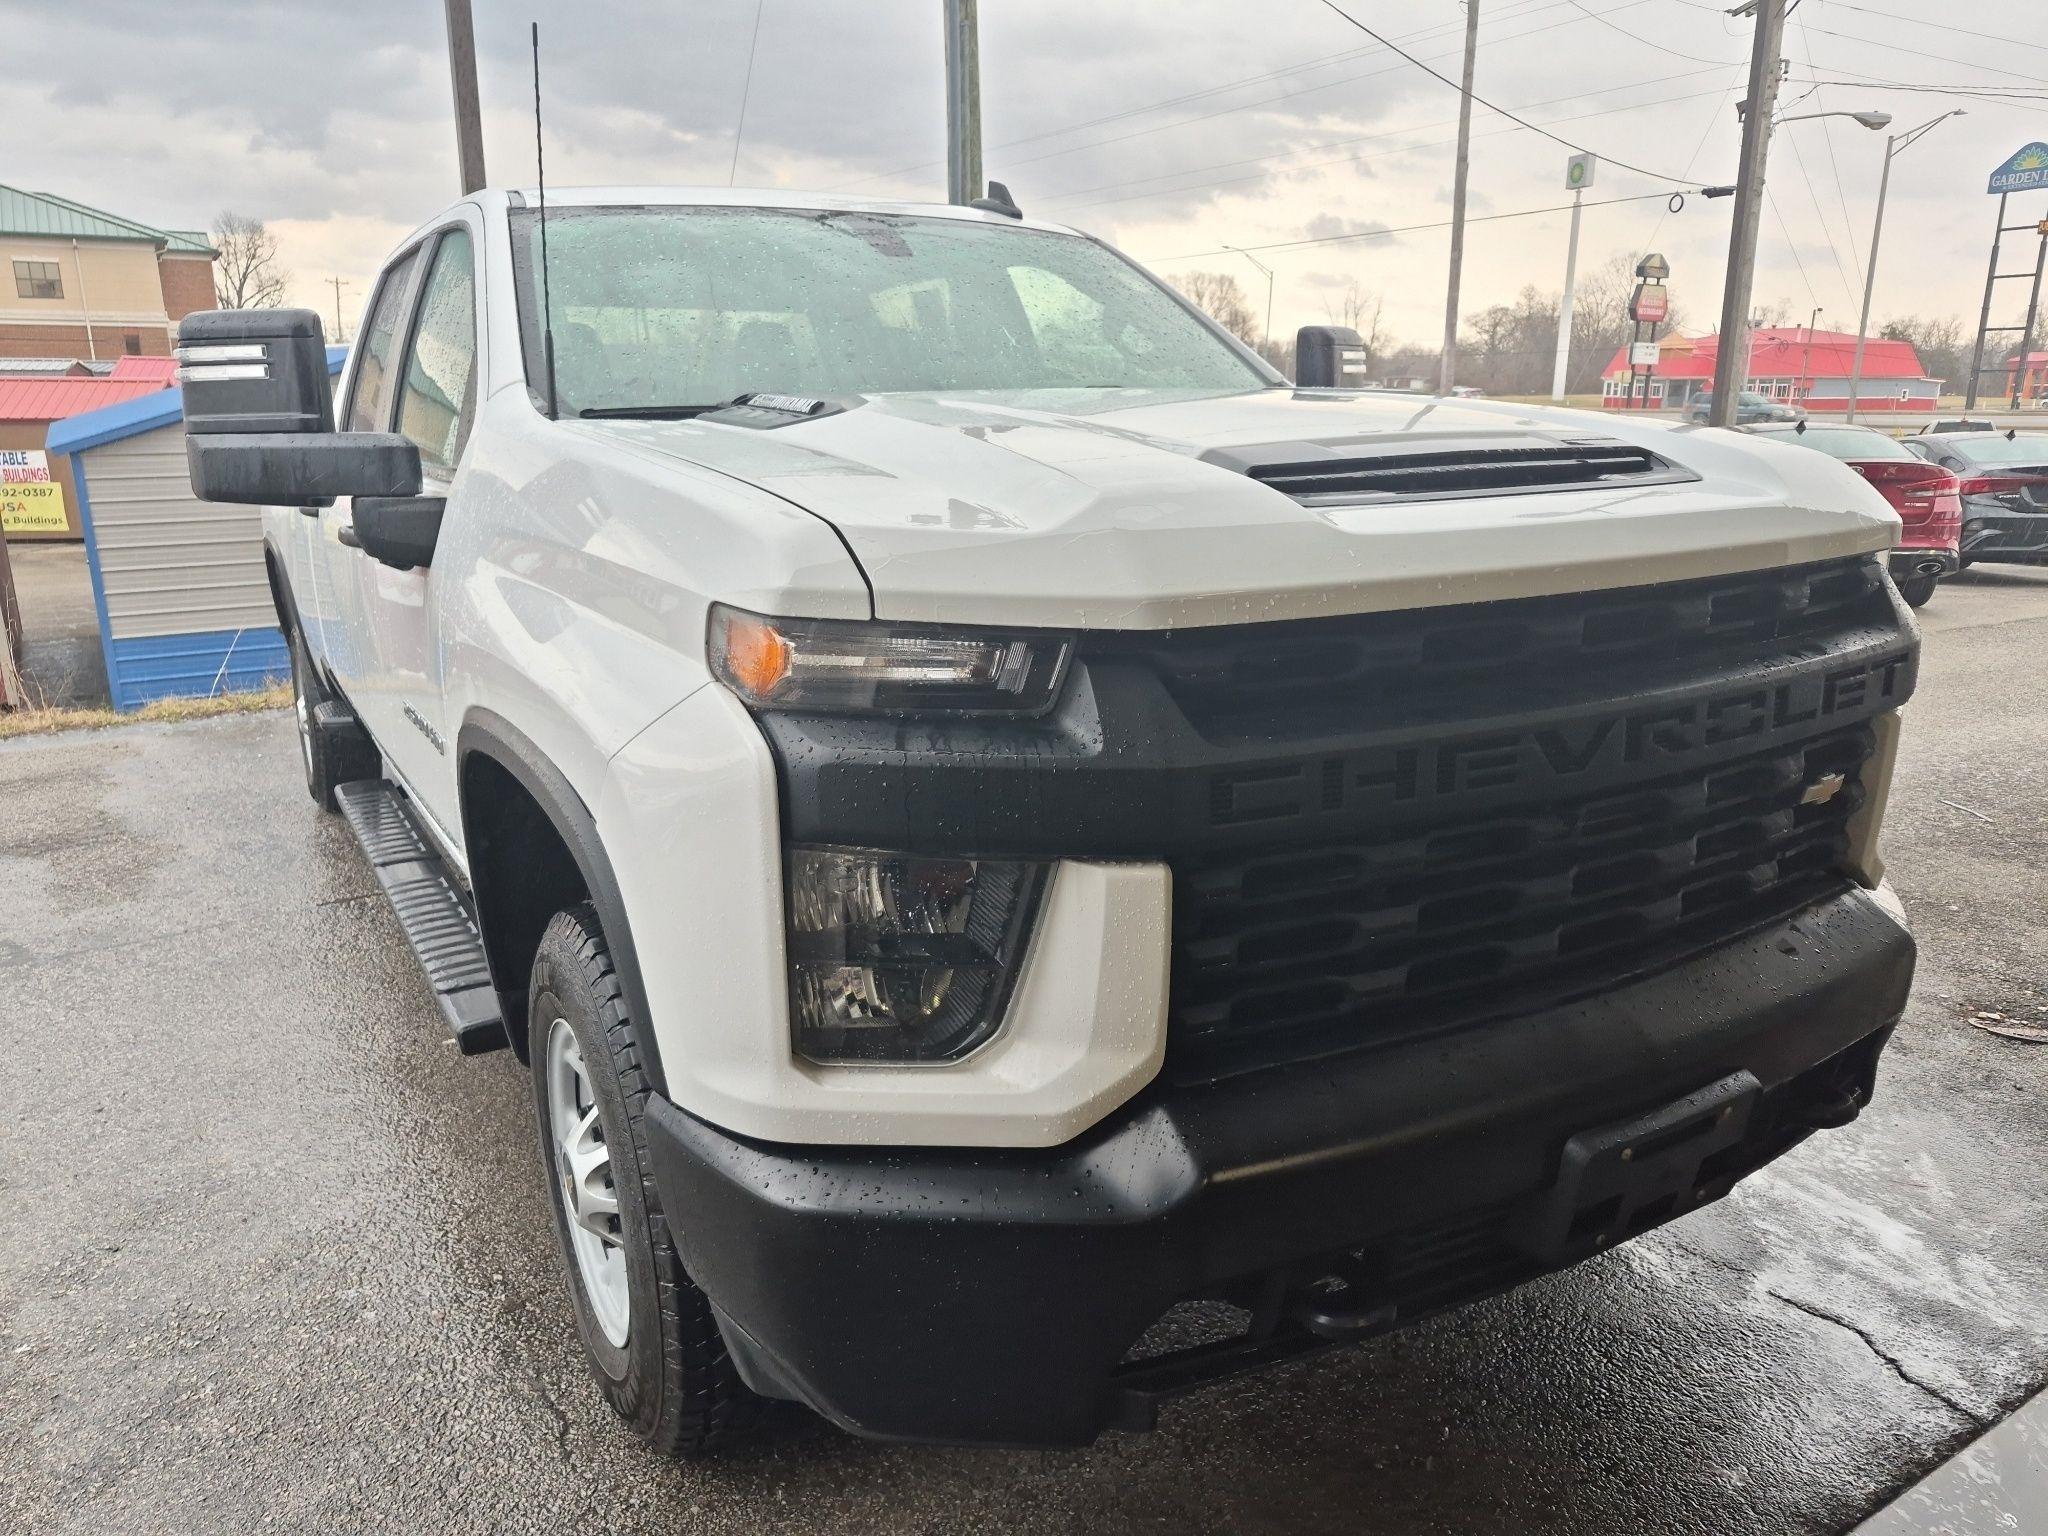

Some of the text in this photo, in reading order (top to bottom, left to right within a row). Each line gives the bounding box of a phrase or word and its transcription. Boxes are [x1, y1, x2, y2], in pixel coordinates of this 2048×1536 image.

[1992, 171, 2040, 187] GARDEN
[0, 451, 28, 466] ABLE
[3, 467, 49, 482] BUILDINGS
[13, 516, 63, 525] Buildings
[1208, 653, 1909, 826] CHEVROLET
